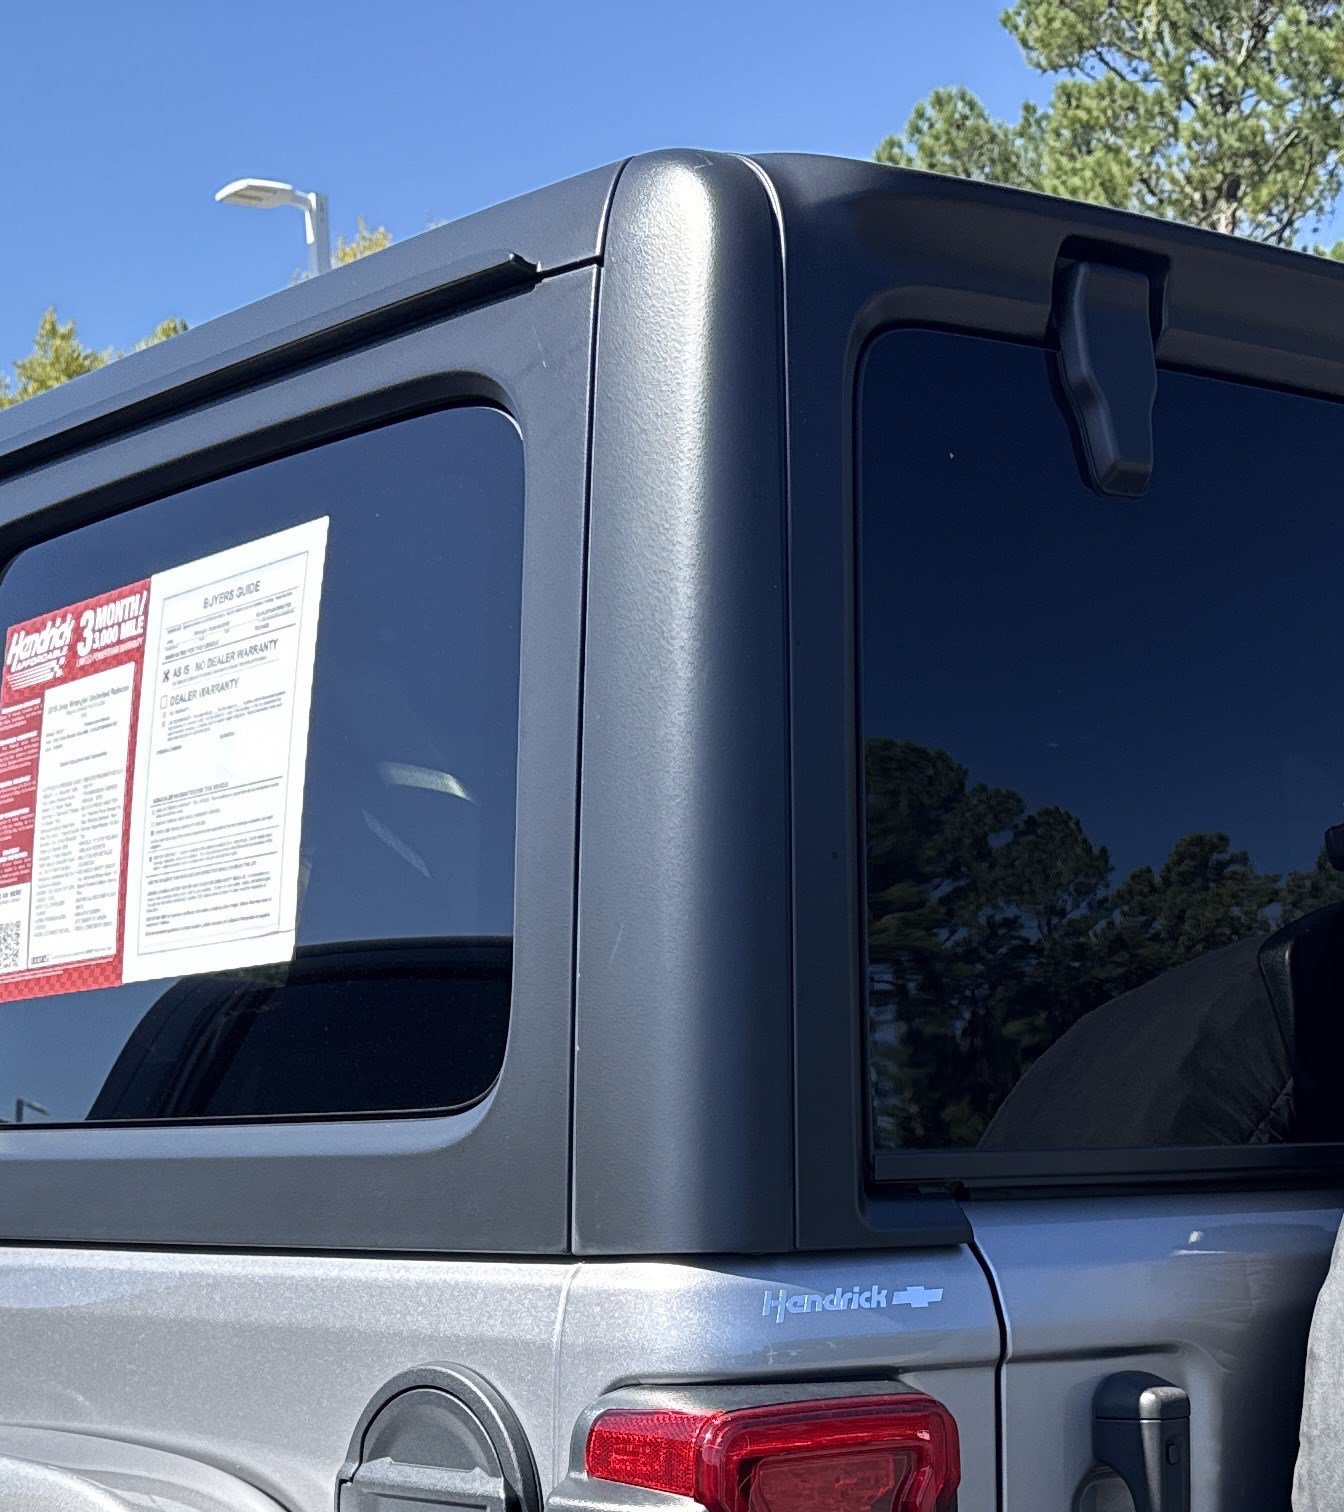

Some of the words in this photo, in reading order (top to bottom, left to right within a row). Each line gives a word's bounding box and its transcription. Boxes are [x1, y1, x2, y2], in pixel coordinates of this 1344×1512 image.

[203, 588, 234, 609] BUYERS
[236, 580, 261, 599] GUIDE
[6, 613, 75, 673] Hendrick
[77, 610, 95, 657] 3
[119, 615, 145, 641] MILE
[195, 660, 206, 671] NO
[207, 651, 236, 668] DEALER
[237, 638, 279, 659] WARRANTY
[169, 689, 198, 707] DEALER
[199, 677, 240, 698] WARRANTY
[761, 1284, 888, 1324] Hendrick
